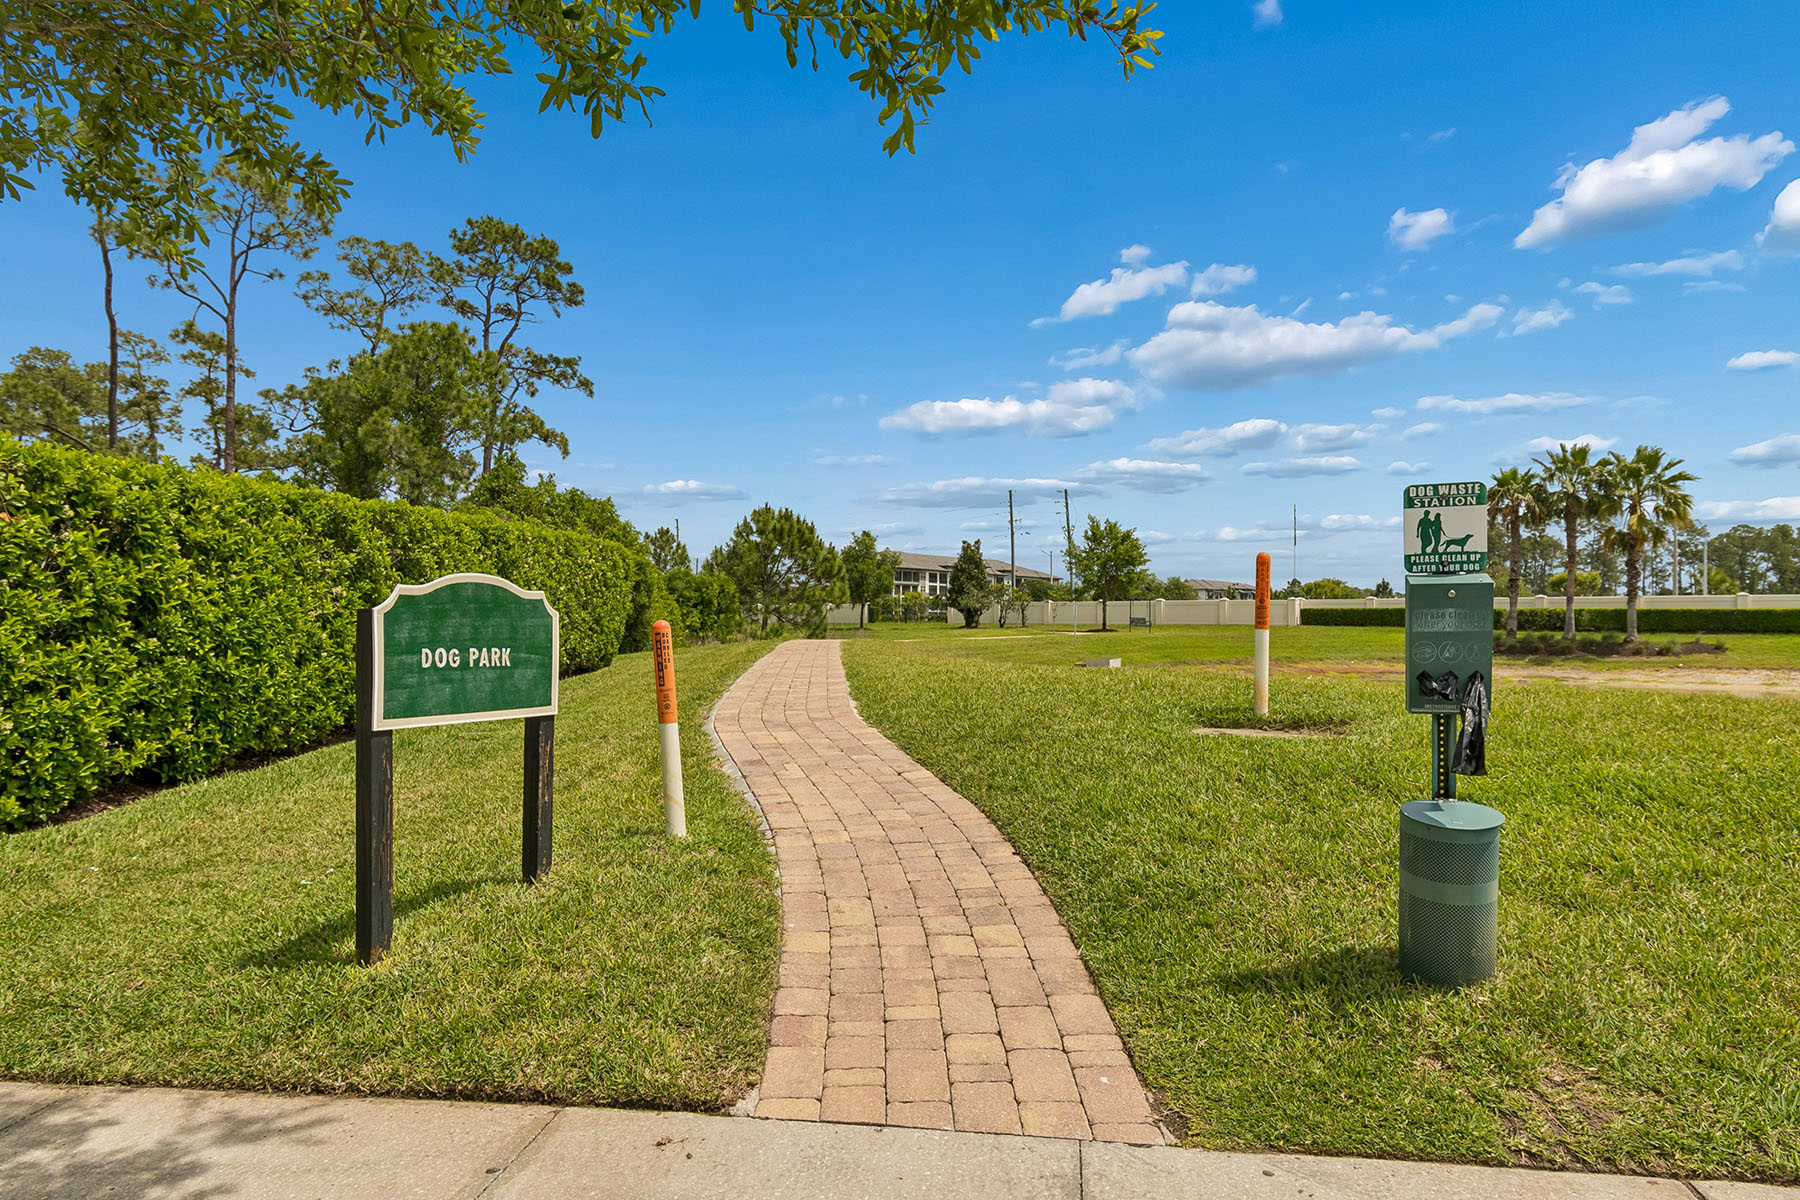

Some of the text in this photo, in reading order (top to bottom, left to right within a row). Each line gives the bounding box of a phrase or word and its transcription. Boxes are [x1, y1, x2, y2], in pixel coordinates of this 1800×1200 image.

[1409, 483, 1480, 497] DOG WASTE
[1413, 496, 1477, 508] STATION
[1410, 553, 1481, 563] PLEASE CLEAN UP
[1412, 564, 1436, 572] AFTER
[1463, 563, 1480, 571] DOG
[1442, 621, 1463, 630] your
[421, 647, 511, 668] DOG PARK
